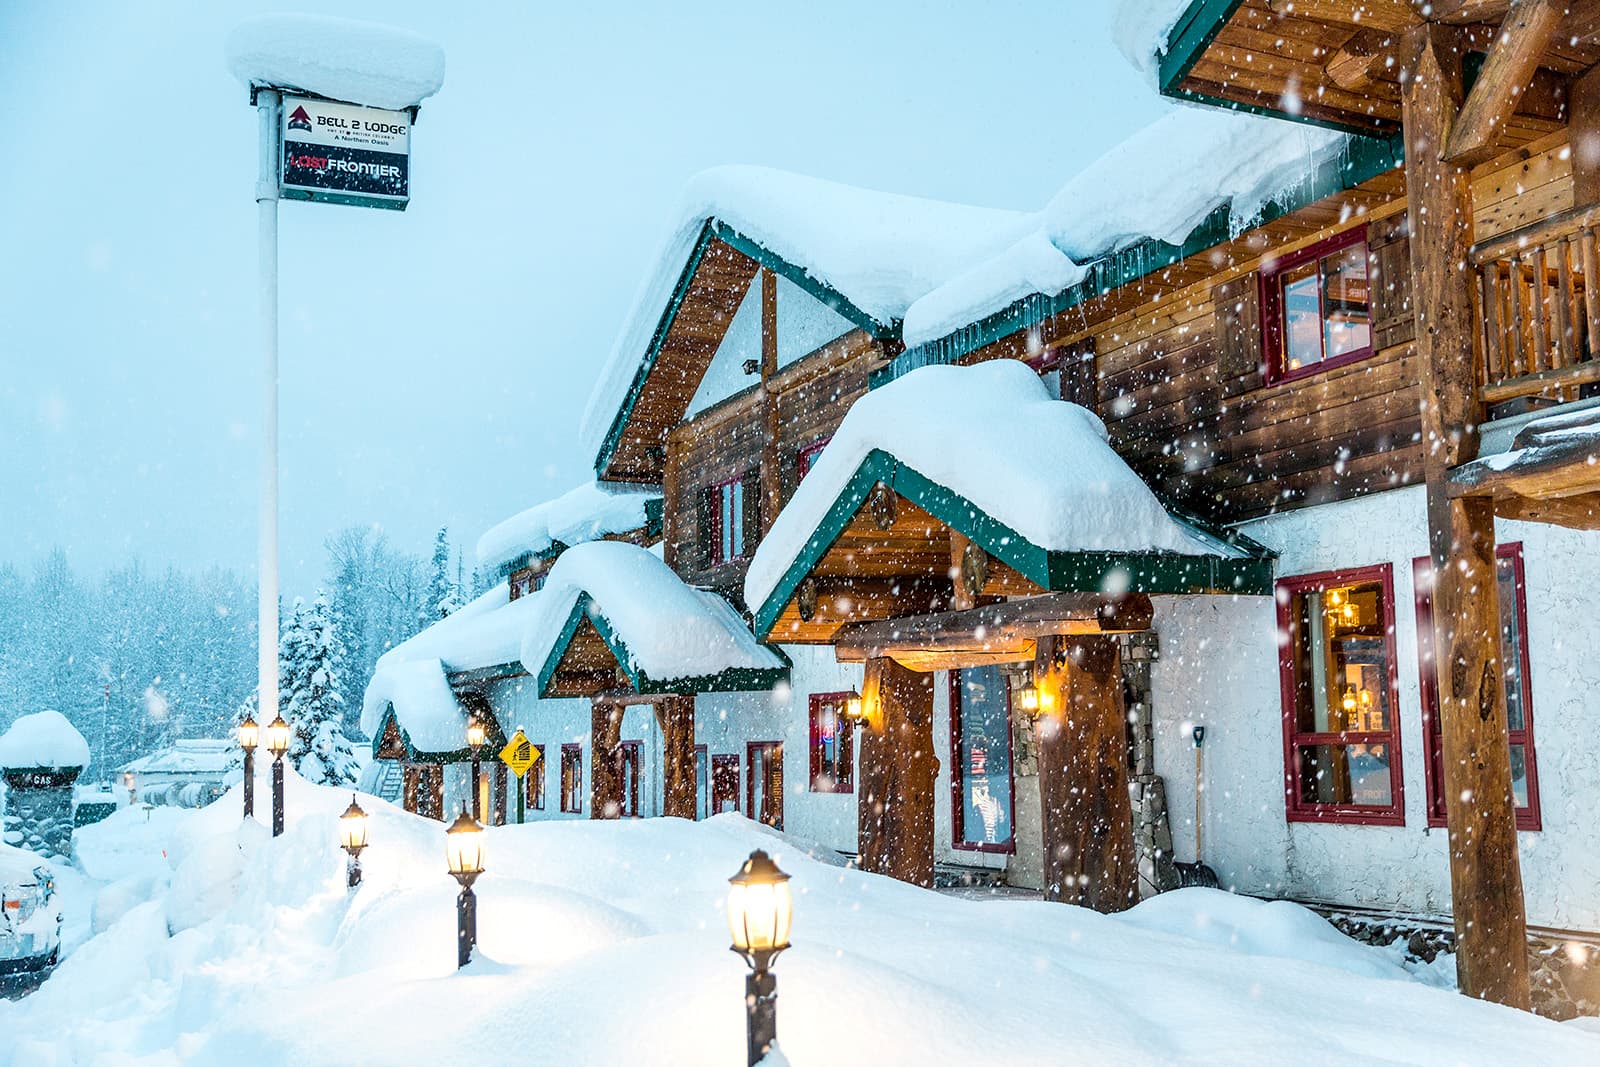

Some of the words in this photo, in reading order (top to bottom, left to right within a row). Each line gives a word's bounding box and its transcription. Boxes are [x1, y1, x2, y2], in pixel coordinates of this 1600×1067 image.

[317, 116, 347, 128] BELL
[351, 120, 360, 129] 2
[365, 122, 406, 135] LODGE
[341, 135, 370, 144] Northern
[34, 776, 51, 784] GAS
